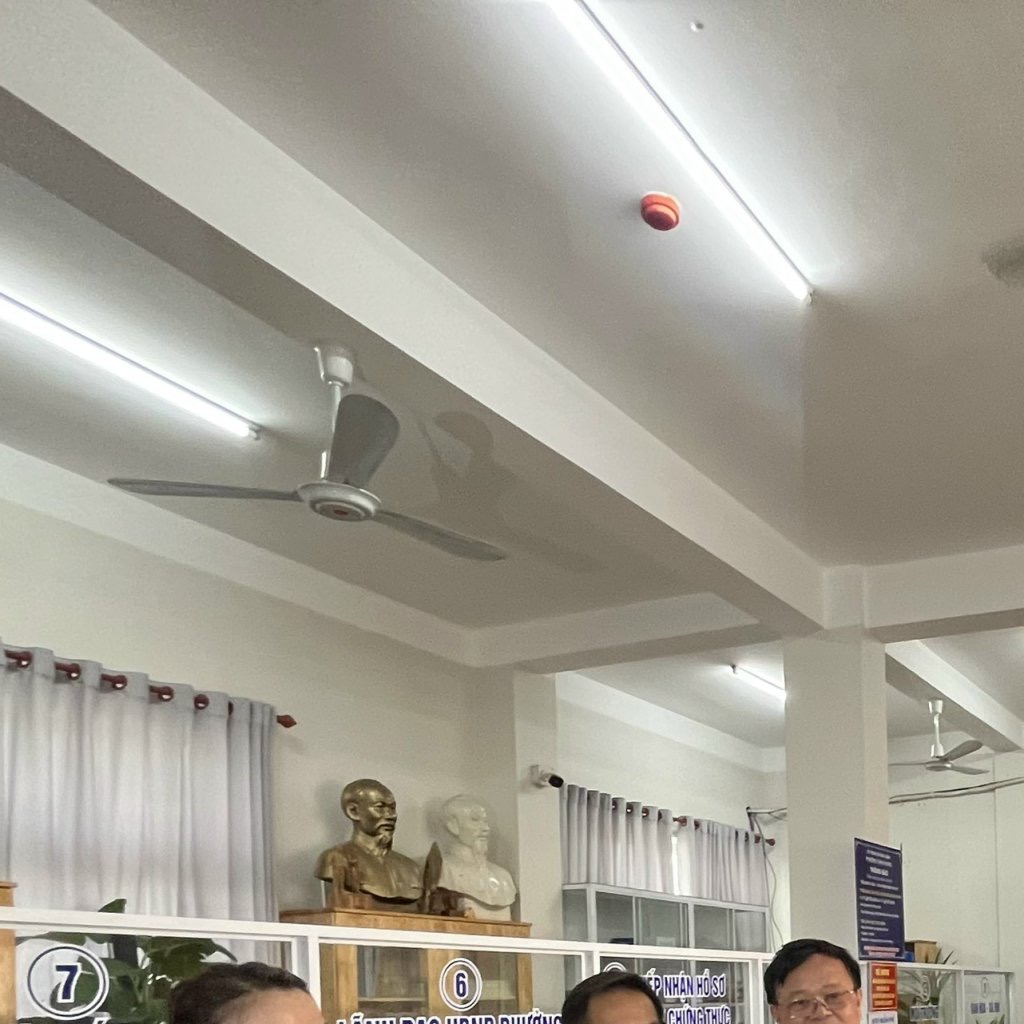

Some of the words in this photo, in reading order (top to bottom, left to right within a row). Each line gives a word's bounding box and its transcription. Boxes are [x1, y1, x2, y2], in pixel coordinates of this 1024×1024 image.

[55, 964, 82, 1003] 7
[454, 970, 467, 998] 6
[663, 970, 693, 1002] NHẬN
[696, 969, 711, 997] HỒ
[712, 973, 726, 997] SƠ
